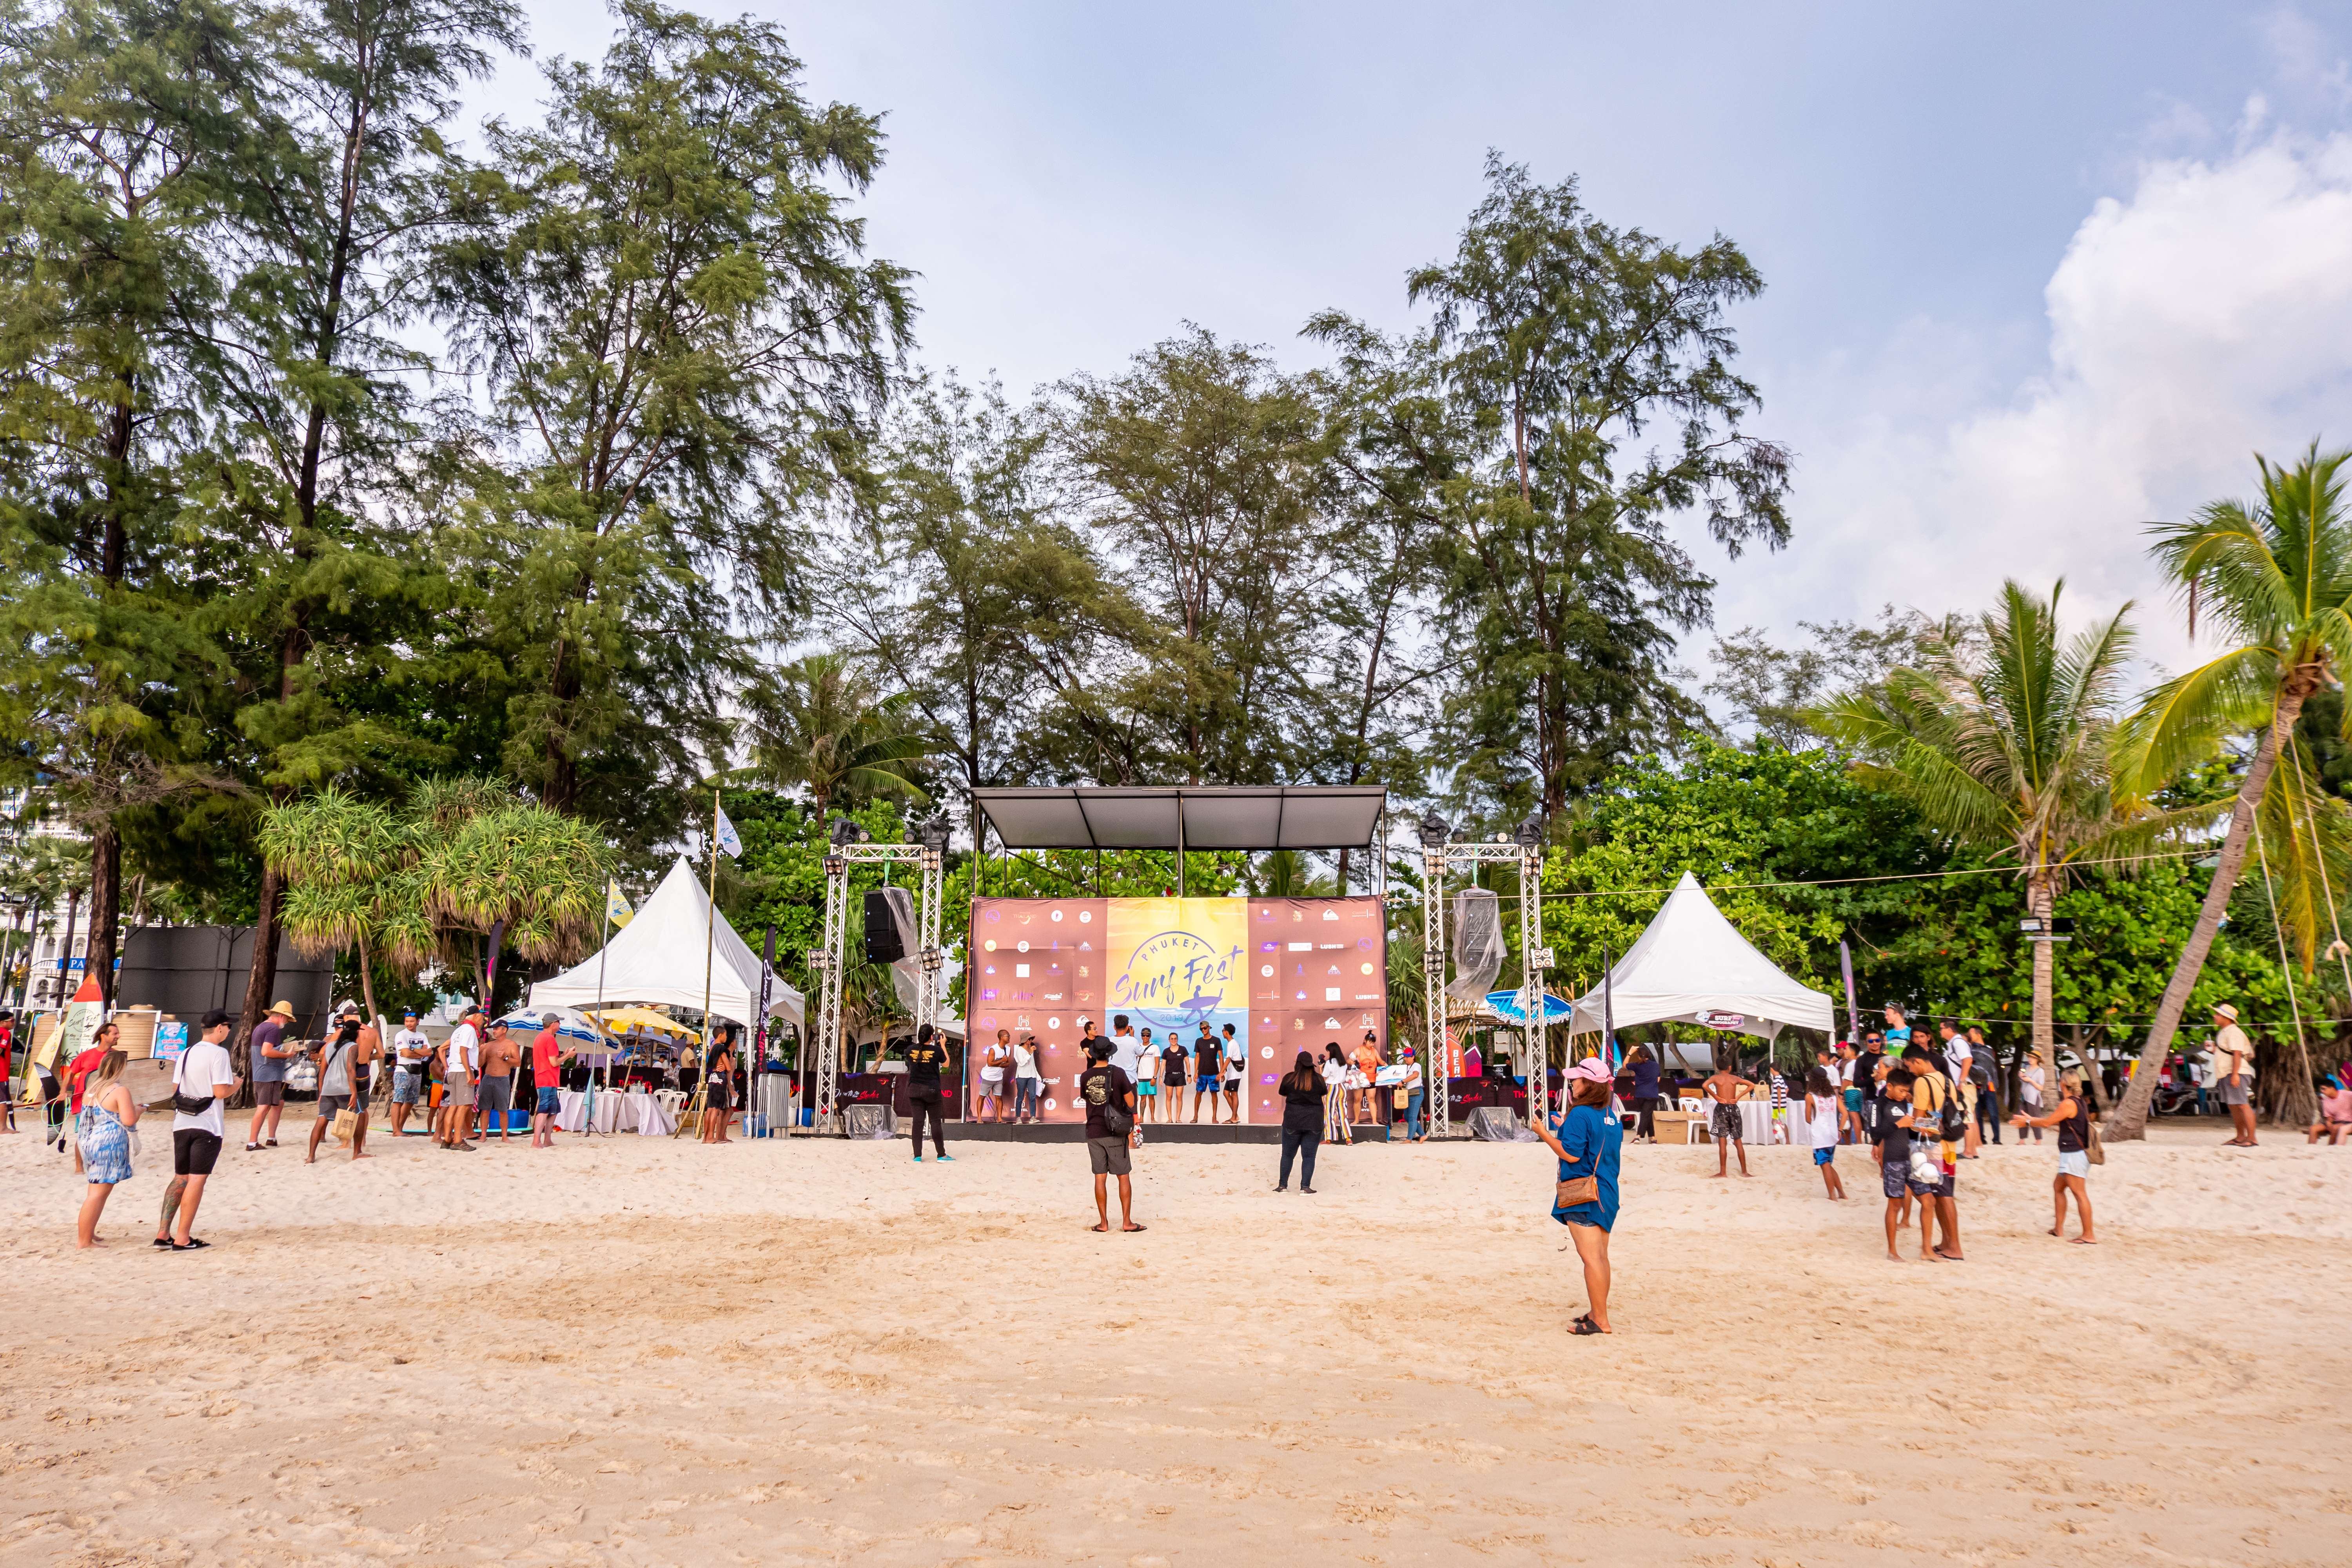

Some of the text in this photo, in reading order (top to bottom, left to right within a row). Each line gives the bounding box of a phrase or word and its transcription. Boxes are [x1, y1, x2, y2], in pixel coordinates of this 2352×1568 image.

[1141, 938, 1198, 961] PHUKET
[1110, 945, 1244, 1007] Surf Fest
[857, 1090, 879, 1100] Shades
[1460, 1093, 1482, 1103] Shades
